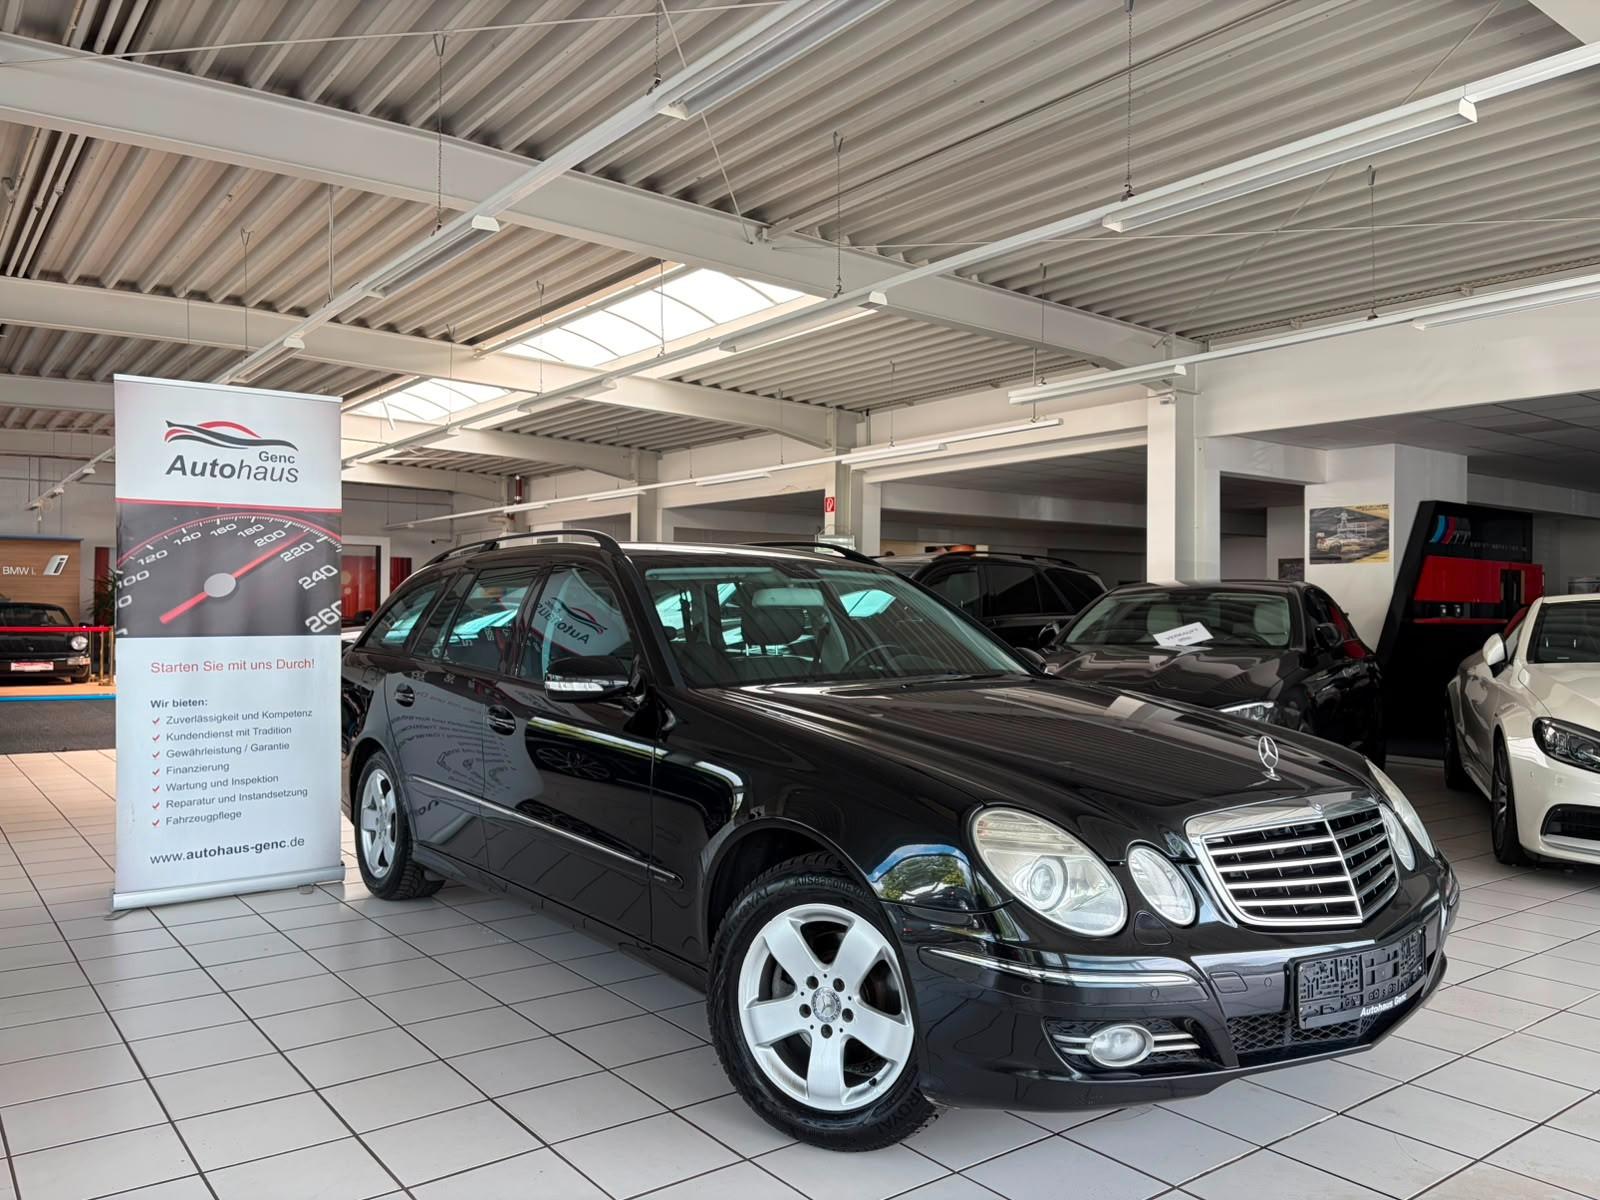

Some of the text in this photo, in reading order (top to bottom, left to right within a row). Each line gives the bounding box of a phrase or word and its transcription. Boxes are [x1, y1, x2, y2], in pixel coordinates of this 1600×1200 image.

[258, 451, 296, 464] Genc
[165, 455, 299, 483] Autohaus
[210, 523, 237, 537] 160
[237, 524, 264, 538] 180
[173, 531, 202, 546] 140
[254, 529, 286, 548] 200
[137, 549, 168, 566] 120
[280, 541, 314, 562] 220
[2, 566, 30, 575] BMW
[298, 564, 338, 590] 240
[150, 658, 316, 674] Starten Sie mit uns Durch!
[150, 698, 208, 709] Wir bieten:
[166, 709, 313, 725] Zuverlässigkeit und Kompetenz
[166, 726, 292, 742] Kundendienst mit Tradition
[166, 742, 290, 759] Gewährleistung / Garantie
[166, 763, 230, 776] Finanzierung
[166, 775, 279, 793] Wartung und Inspektion
[166, 788, 308, 810] Reparatur und Instandsetzung
[166, 810, 242, 826] Fahrzeugpflege
[149, 836, 305, 864] www.autohaus-genc.de
[1360, 1000, 1393, 1017] Autohaus
